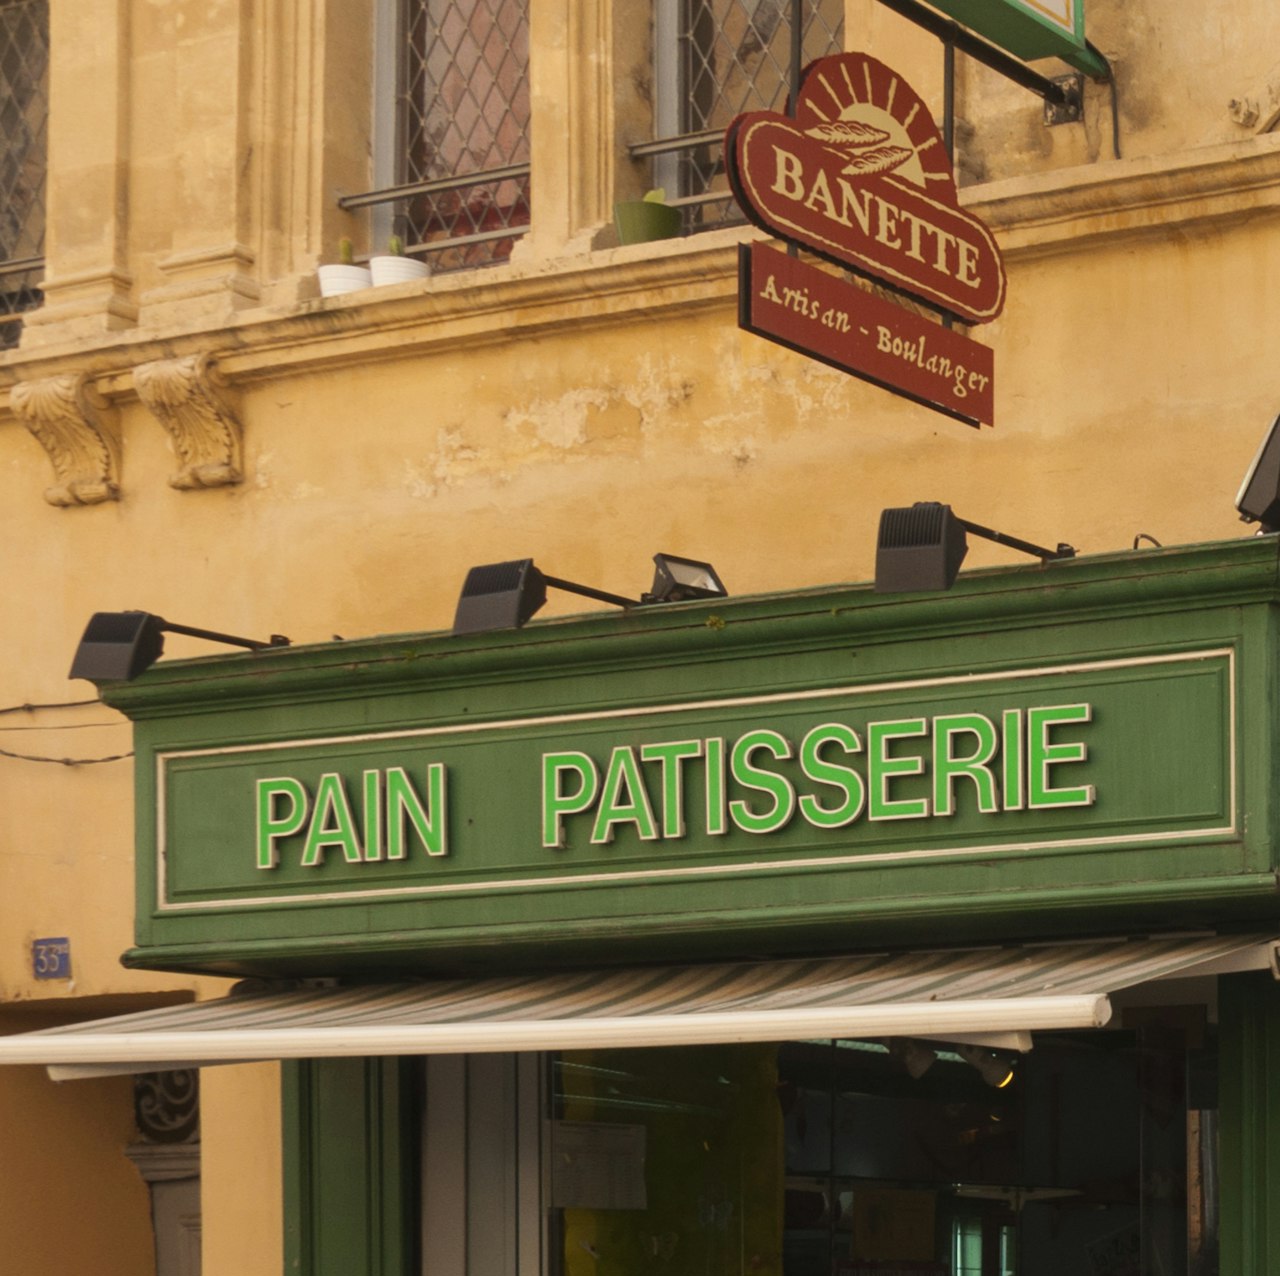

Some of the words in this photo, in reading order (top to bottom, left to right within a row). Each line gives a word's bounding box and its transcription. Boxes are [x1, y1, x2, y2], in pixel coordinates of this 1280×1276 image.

[771, 145, 981, 288] BANETTE
[760, 275, 850, 332] Artisan
[876, 324, 989, 397] Boulanger
[256, 763, 448, 870] PAIN
[542, 702, 1096, 848] PATISSERIE
